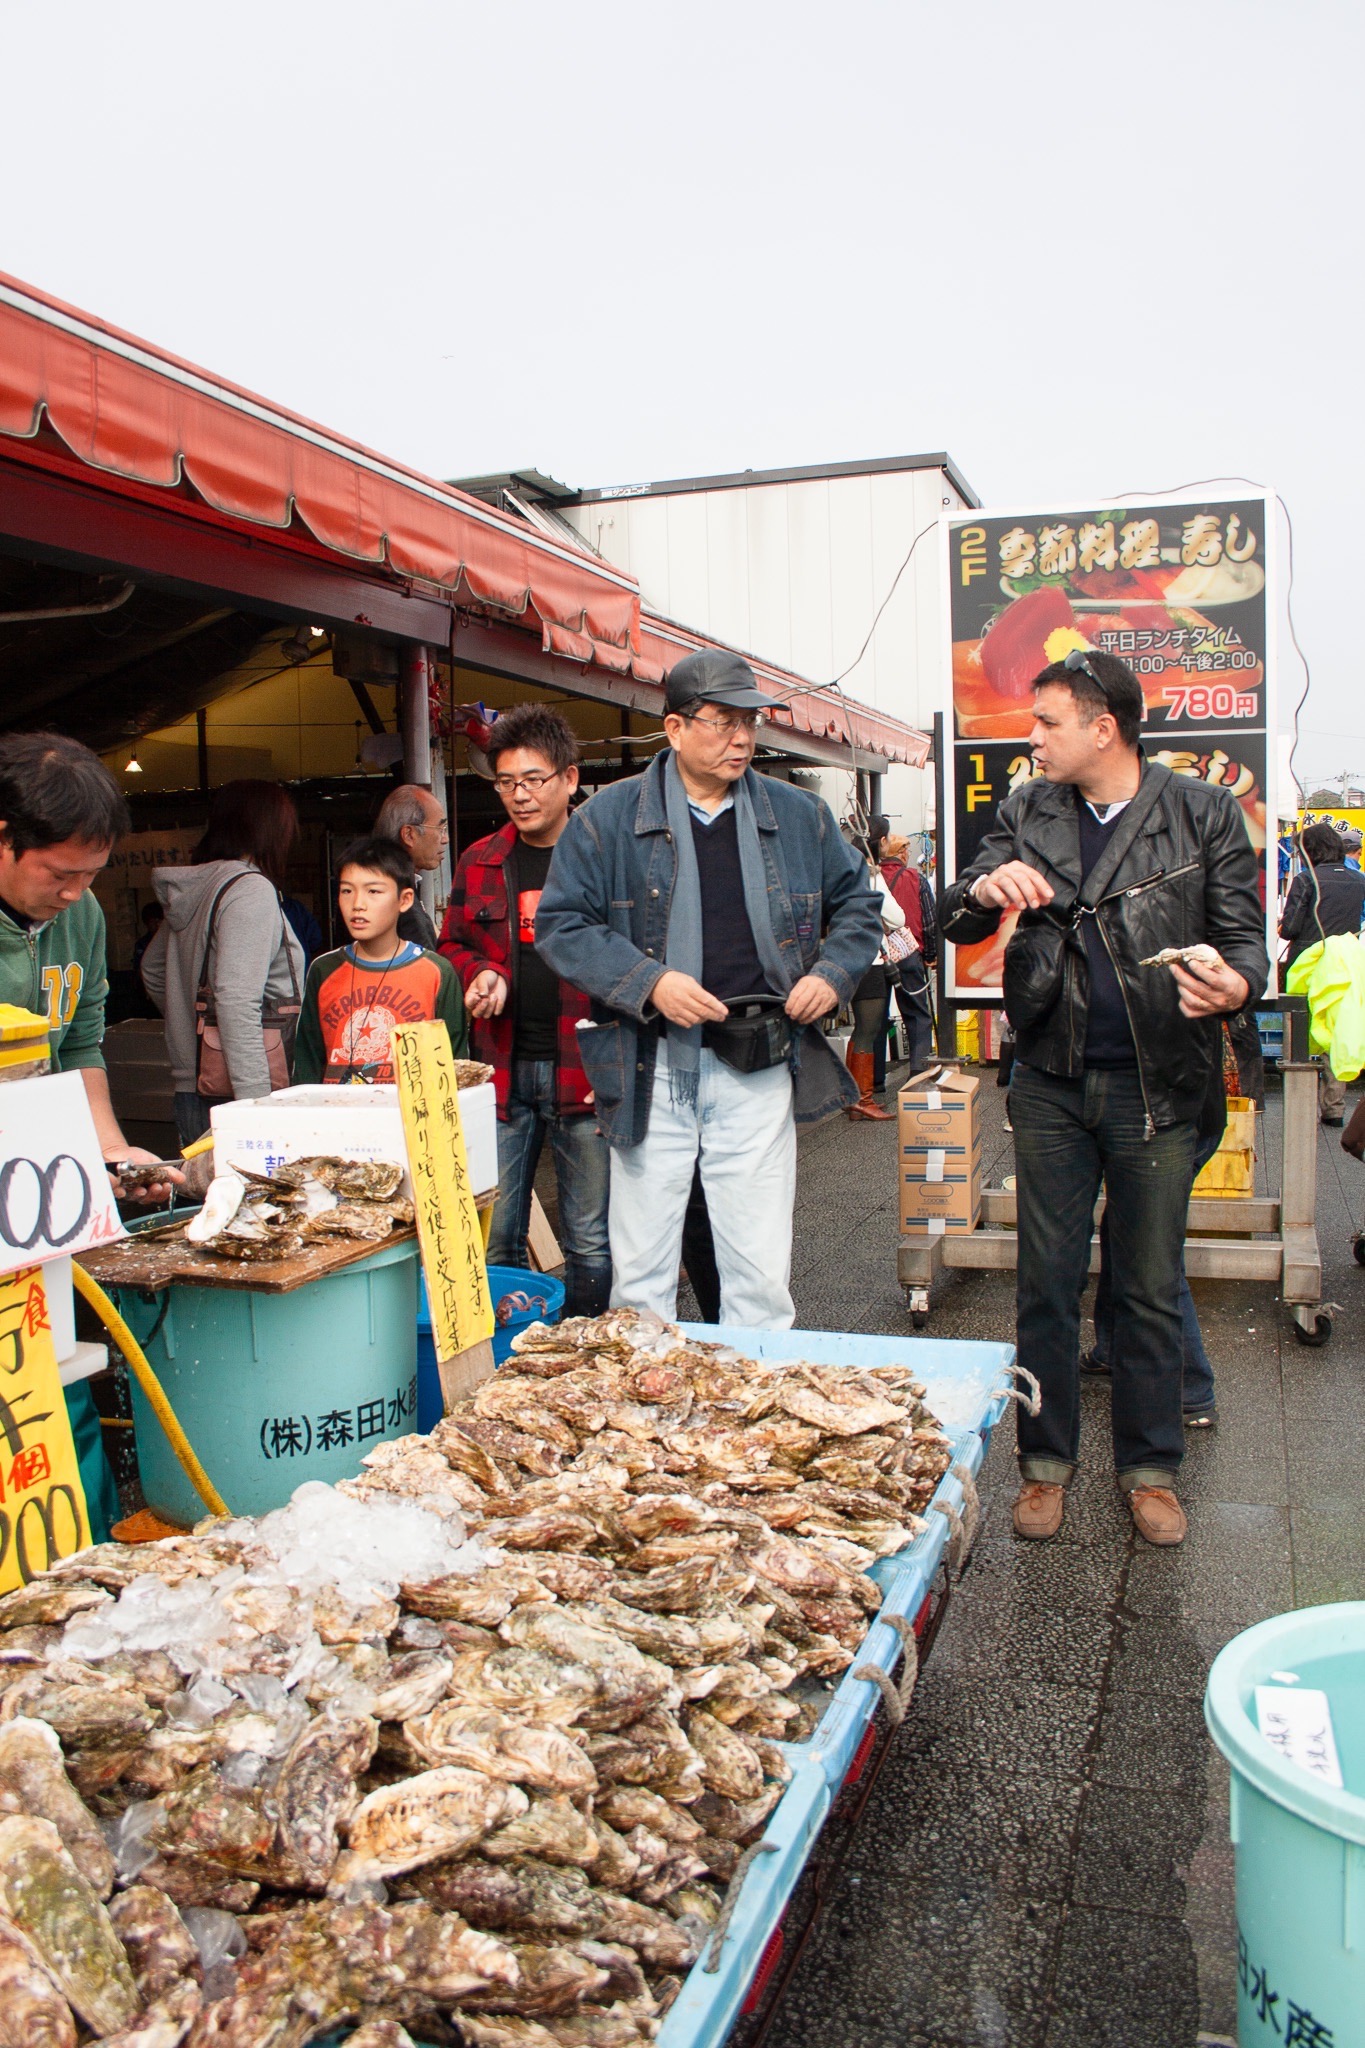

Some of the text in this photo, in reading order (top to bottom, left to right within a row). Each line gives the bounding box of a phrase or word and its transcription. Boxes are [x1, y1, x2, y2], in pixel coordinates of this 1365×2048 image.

[998, 512, 1257, 579] 季節料理 寿し
[1100, 626, 1242, 652] 平日ランチタイム
[1162, 684, 1257, 722] 780円
[41, 962, 83, 1031] 73
